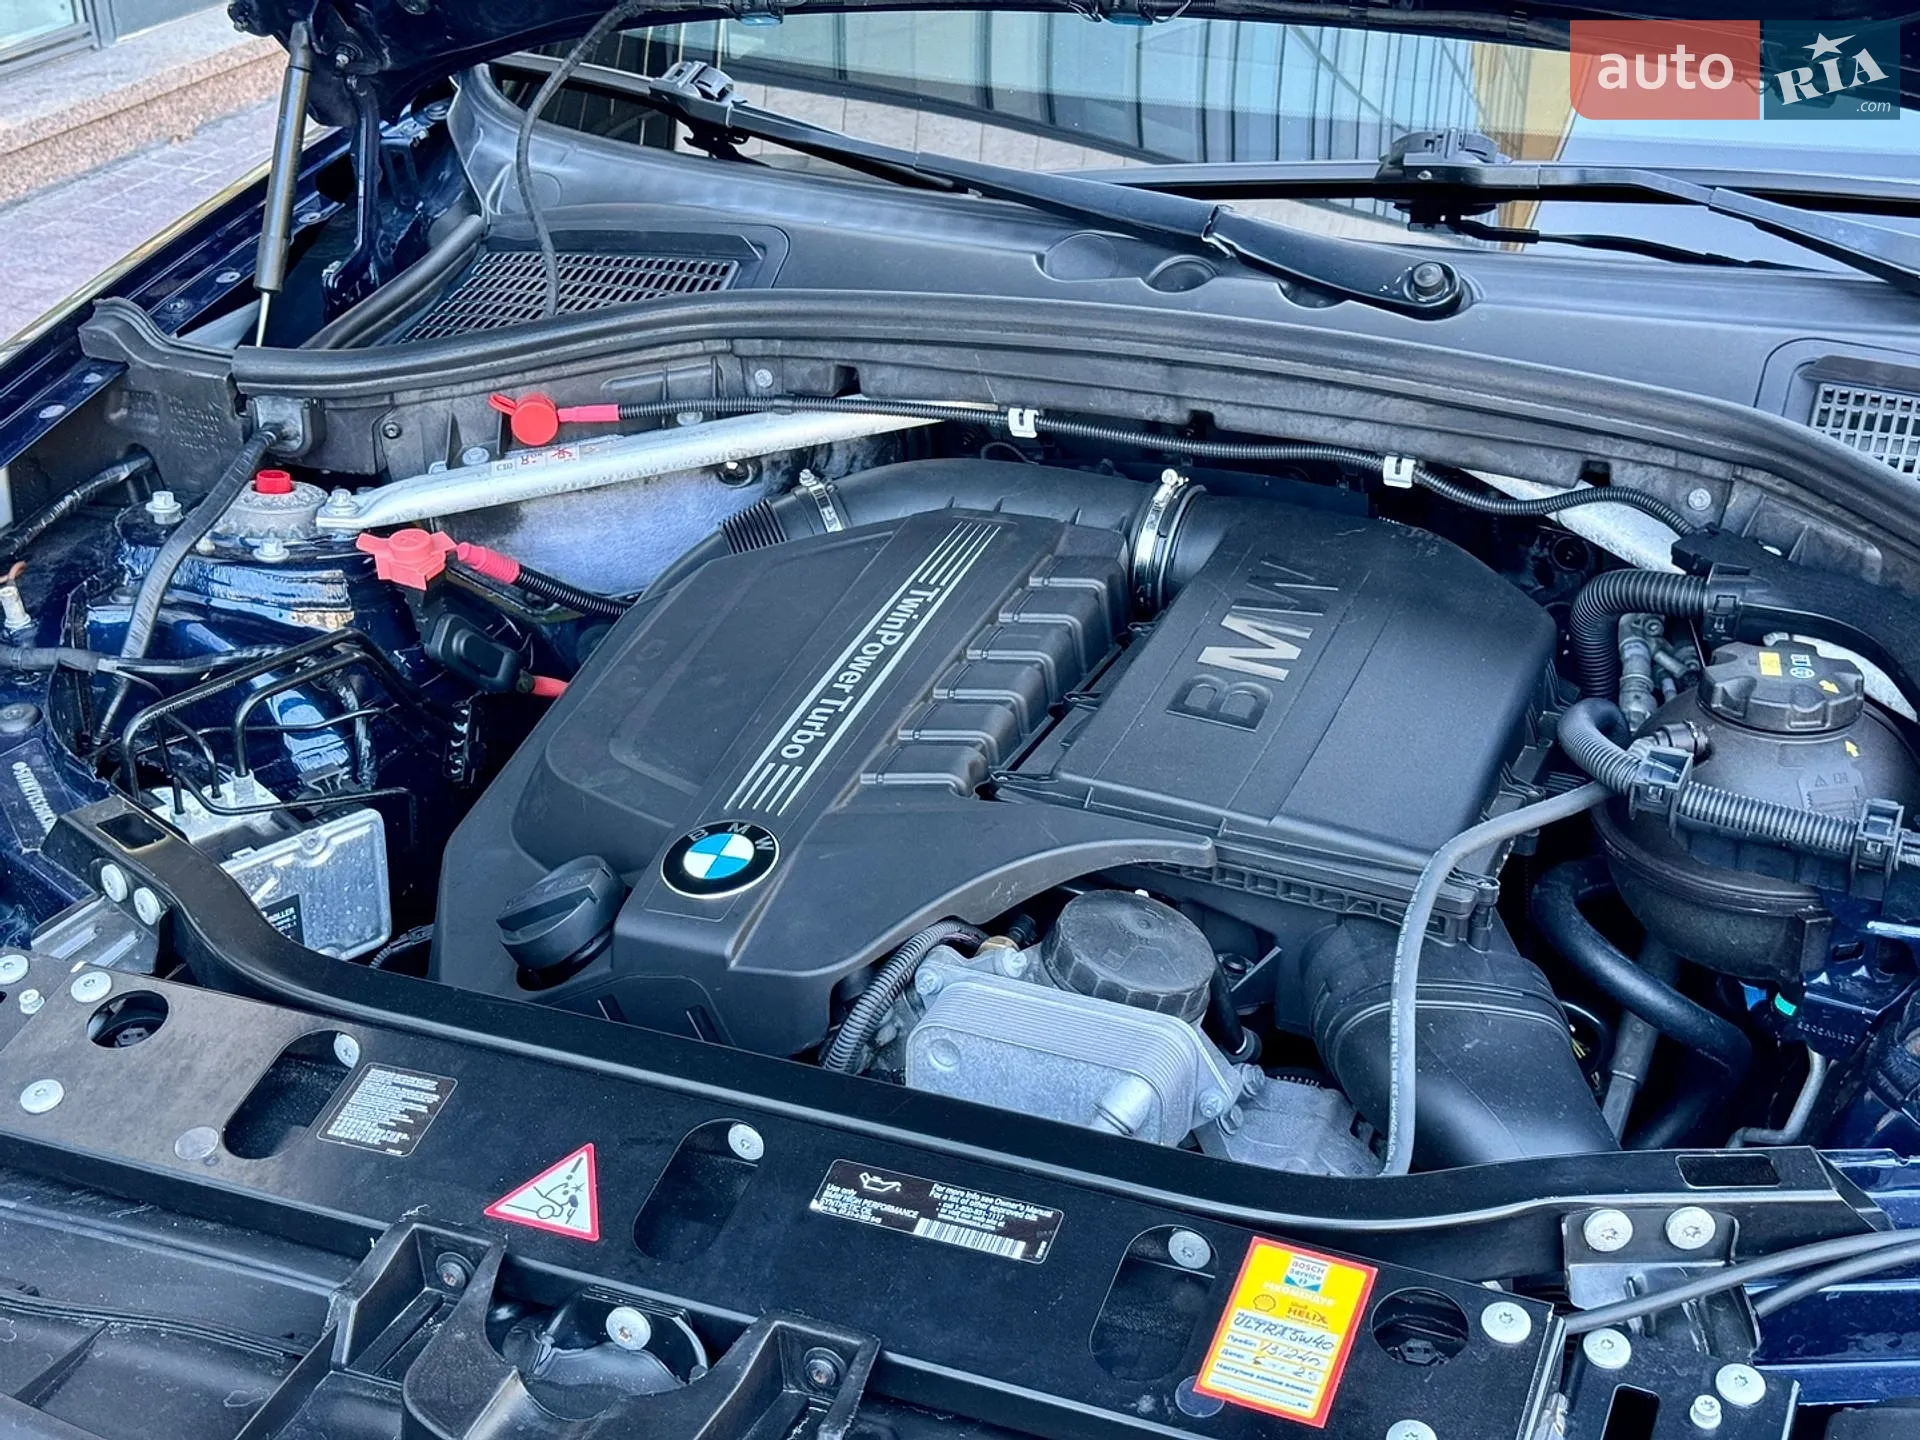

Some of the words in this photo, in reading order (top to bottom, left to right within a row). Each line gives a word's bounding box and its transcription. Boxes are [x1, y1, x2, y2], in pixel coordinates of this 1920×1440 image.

[833, 587, 941, 693] TwinPower
[1166, 555, 1339, 734] BMW
[781, 696, 854, 758] Turbo
[688, 822, 776, 851] BMW
[861, 1198, 919, 1218] PERFORMANCE
[944, 1186, 966, 1197] more
[1024, 1205, 1054, 1217] Manual
[1289, 1267, 1322, 1281] Service
[1291, 1260, 1324, 1274] BOSCH
[1286, 1303, 1330, 1324] HELIX
